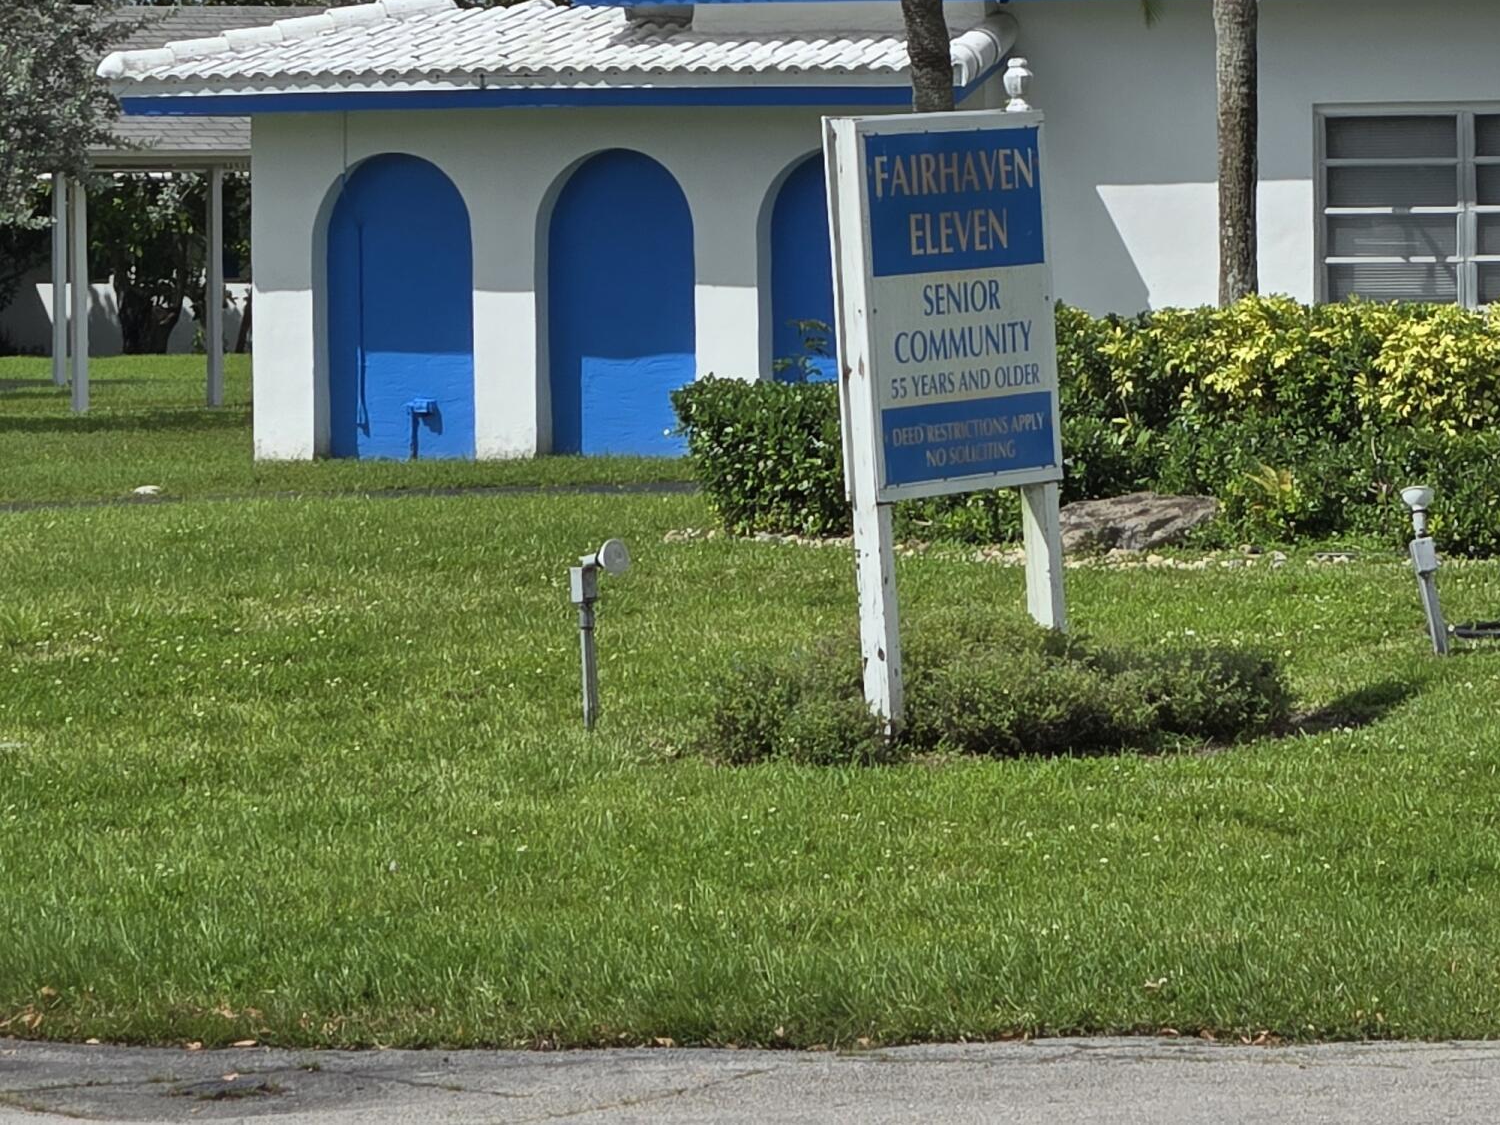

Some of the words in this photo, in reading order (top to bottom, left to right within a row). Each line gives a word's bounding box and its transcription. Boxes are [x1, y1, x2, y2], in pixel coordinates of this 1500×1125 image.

[874, 147, 1034, 197] FAIRHAVEN
[909, 208, 1008, 256] ELEVEN
[922, 279, 1001, 317] SENIOR
[894, 320, 1032, 364] COMMUNITY
[890, 377, 908, 400] 55
[911, 372, 955, 397] YEARS
[958, 368, 991, 392] AND
[994, 363, 1040, 388] OLDER
[892, 427, 924, 448] DEED
[926, 416, 1009, 444] RESTRICTIONS
[1010, 411, 1044, 431] APPLY
[925, 449, 946, 468] NO
[949, 439, 1016, 465] SOLICITING
